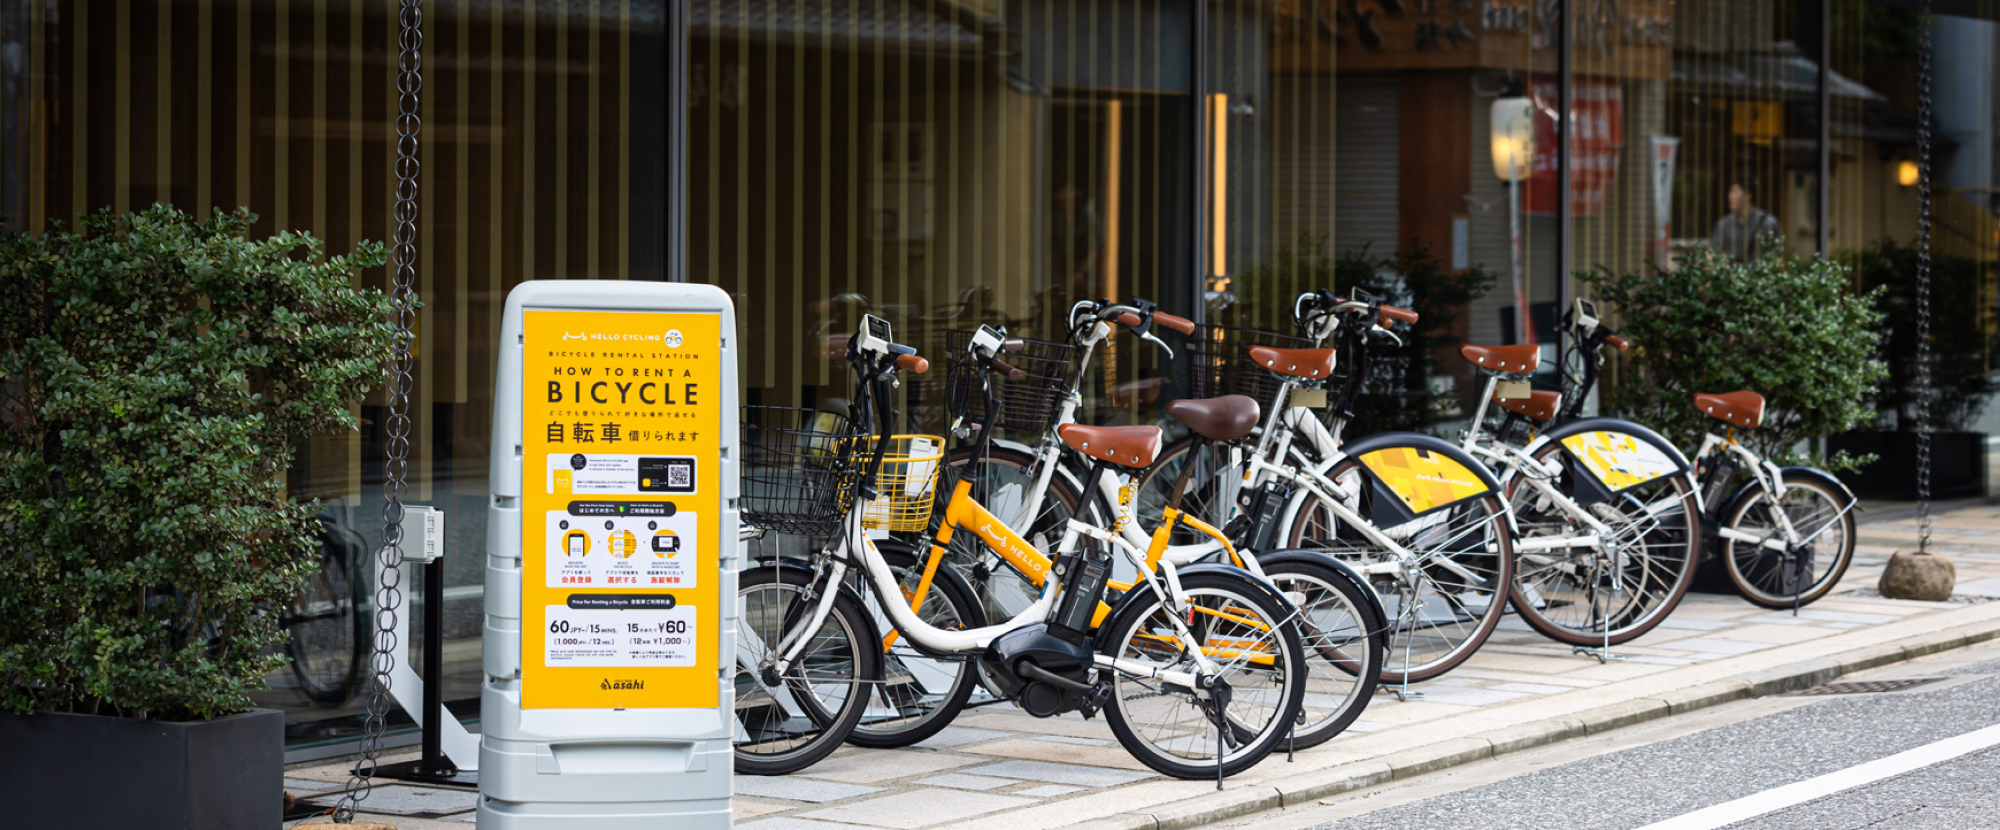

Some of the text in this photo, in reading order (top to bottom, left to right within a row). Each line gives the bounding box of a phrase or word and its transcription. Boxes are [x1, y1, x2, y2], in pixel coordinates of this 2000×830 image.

[622, 333, 660, 341] CYCLING
[554, 367, 692, 378] HOW TO RENT A
[547, 380, 698, 406] BICYCLE
[547, 420, 700, 444] 自転車 借りられます
[1009, 545, 1042, 571] HELLO
[561, 576, 592, 584] 会員登録
[607, 576, 637, 584] 選択する
[613, 679, 645, 690] asahi
